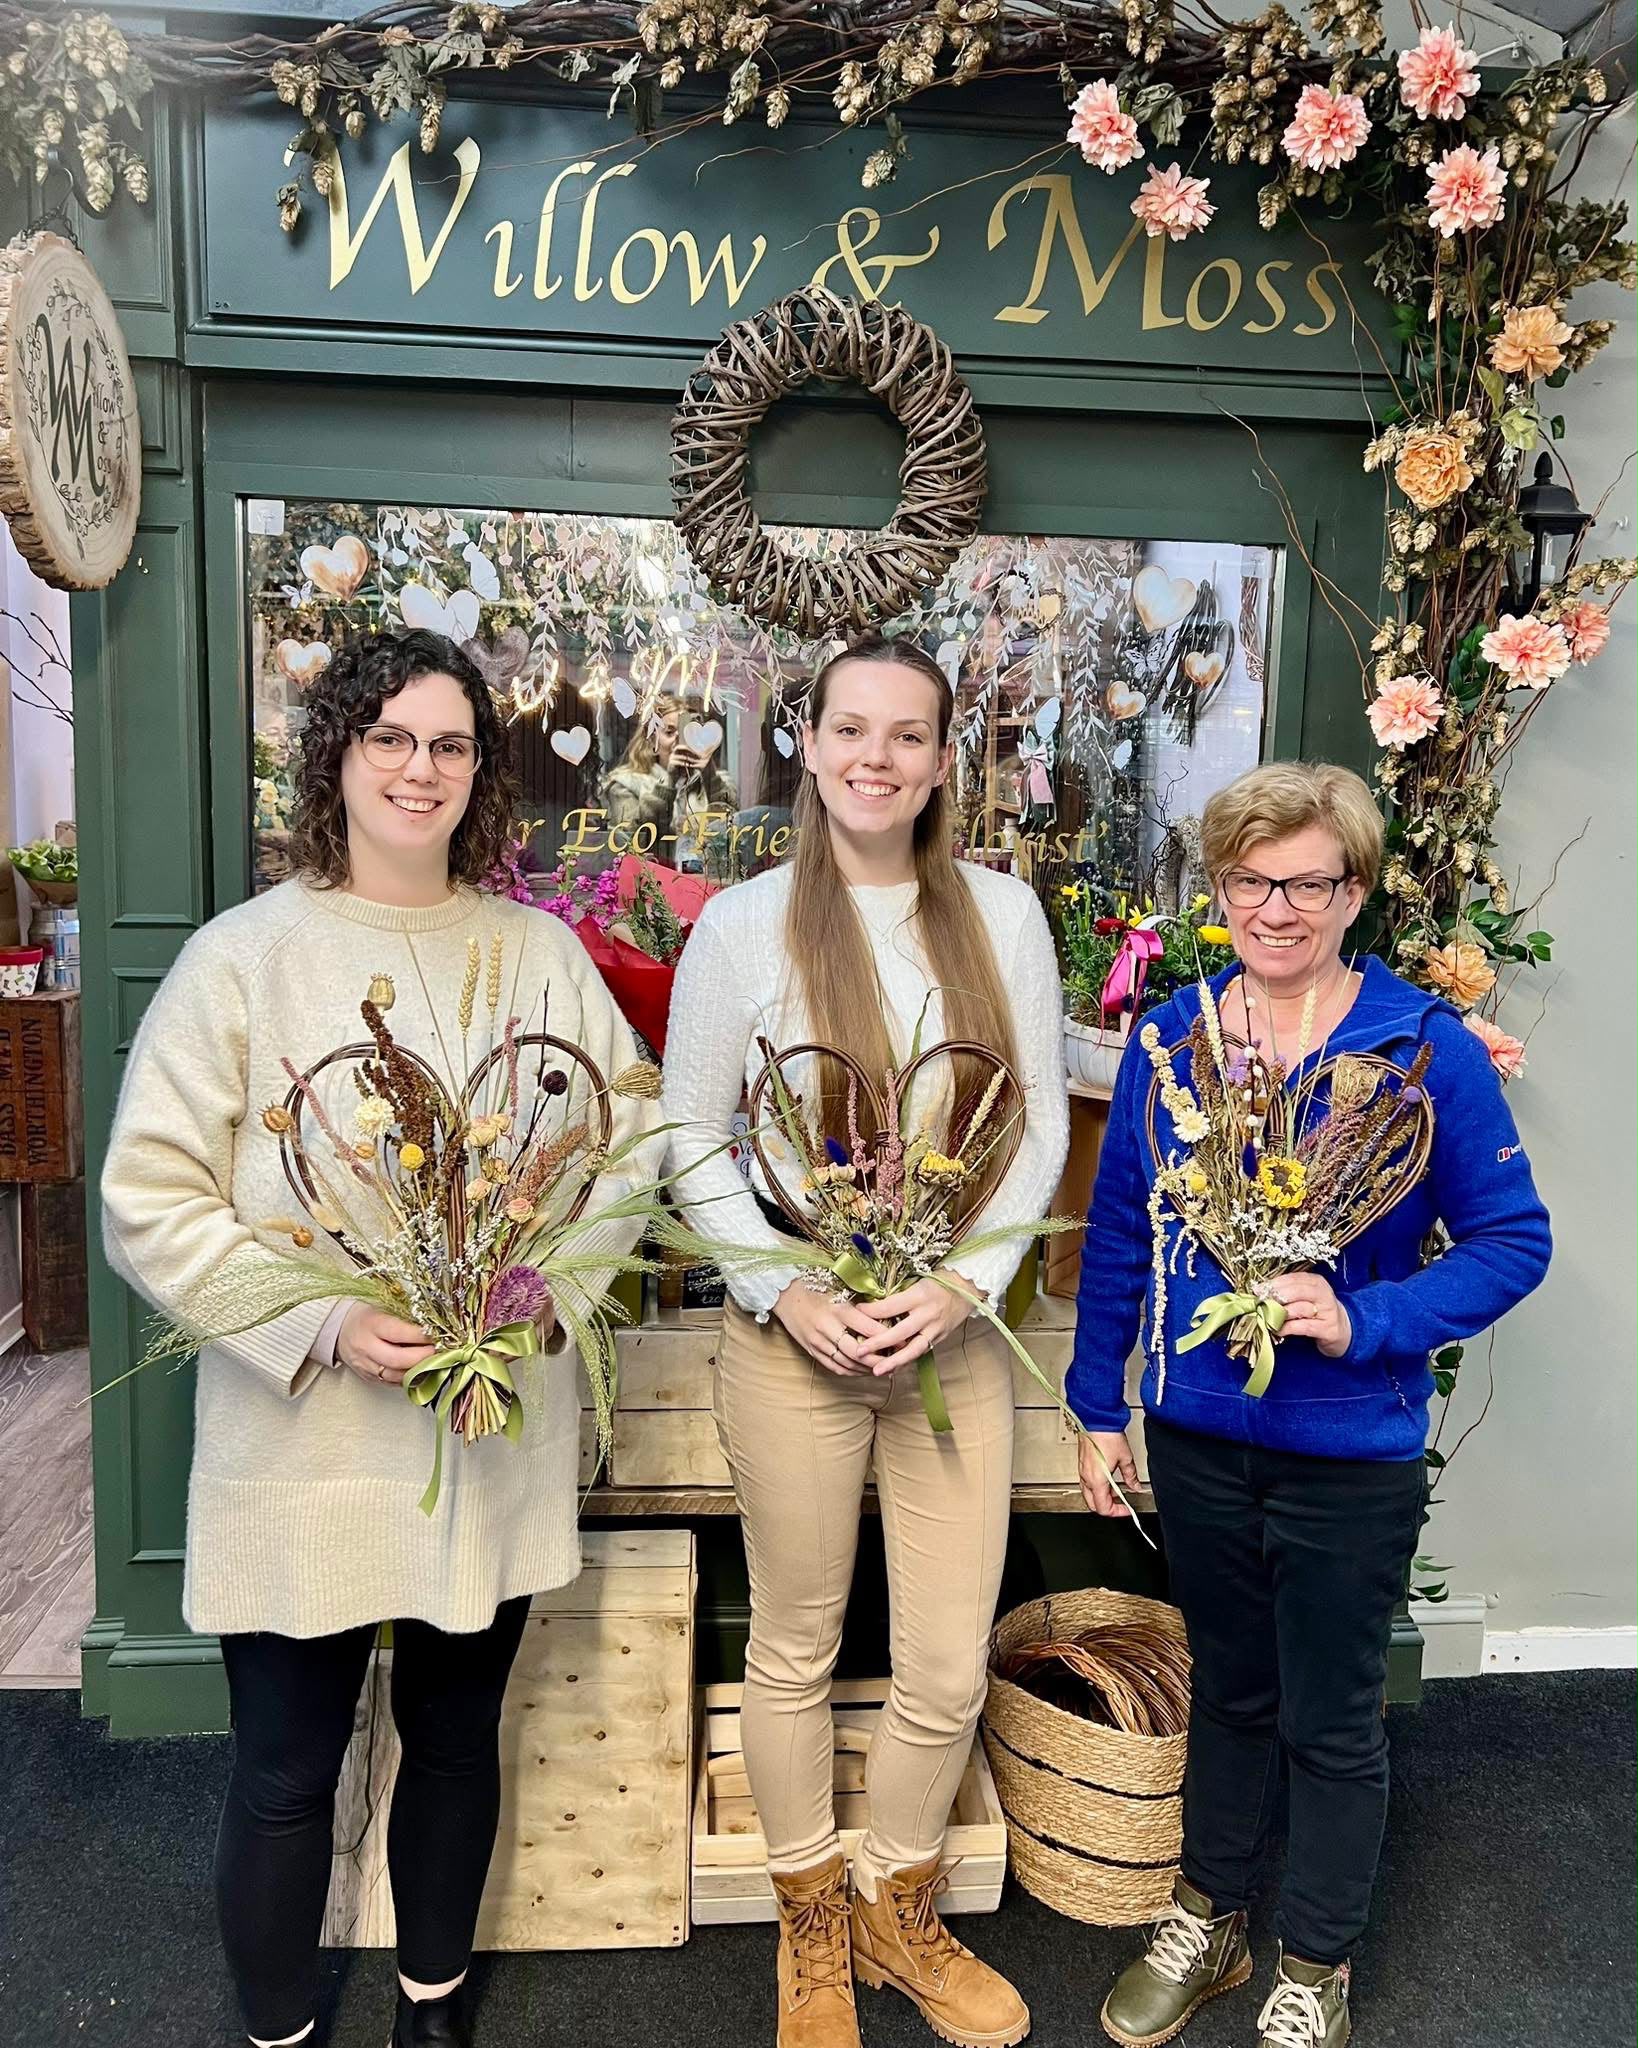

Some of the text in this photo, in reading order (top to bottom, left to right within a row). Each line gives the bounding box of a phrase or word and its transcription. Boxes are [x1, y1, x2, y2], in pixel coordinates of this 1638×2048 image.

[284, 136, 1343, 337] Willow & Moss
[559, 808, 801, 857] Eco-Frie
[952, 807, 1109, 864] lorist'
[21, 1017, 49, 1167] WORTHINGTON
